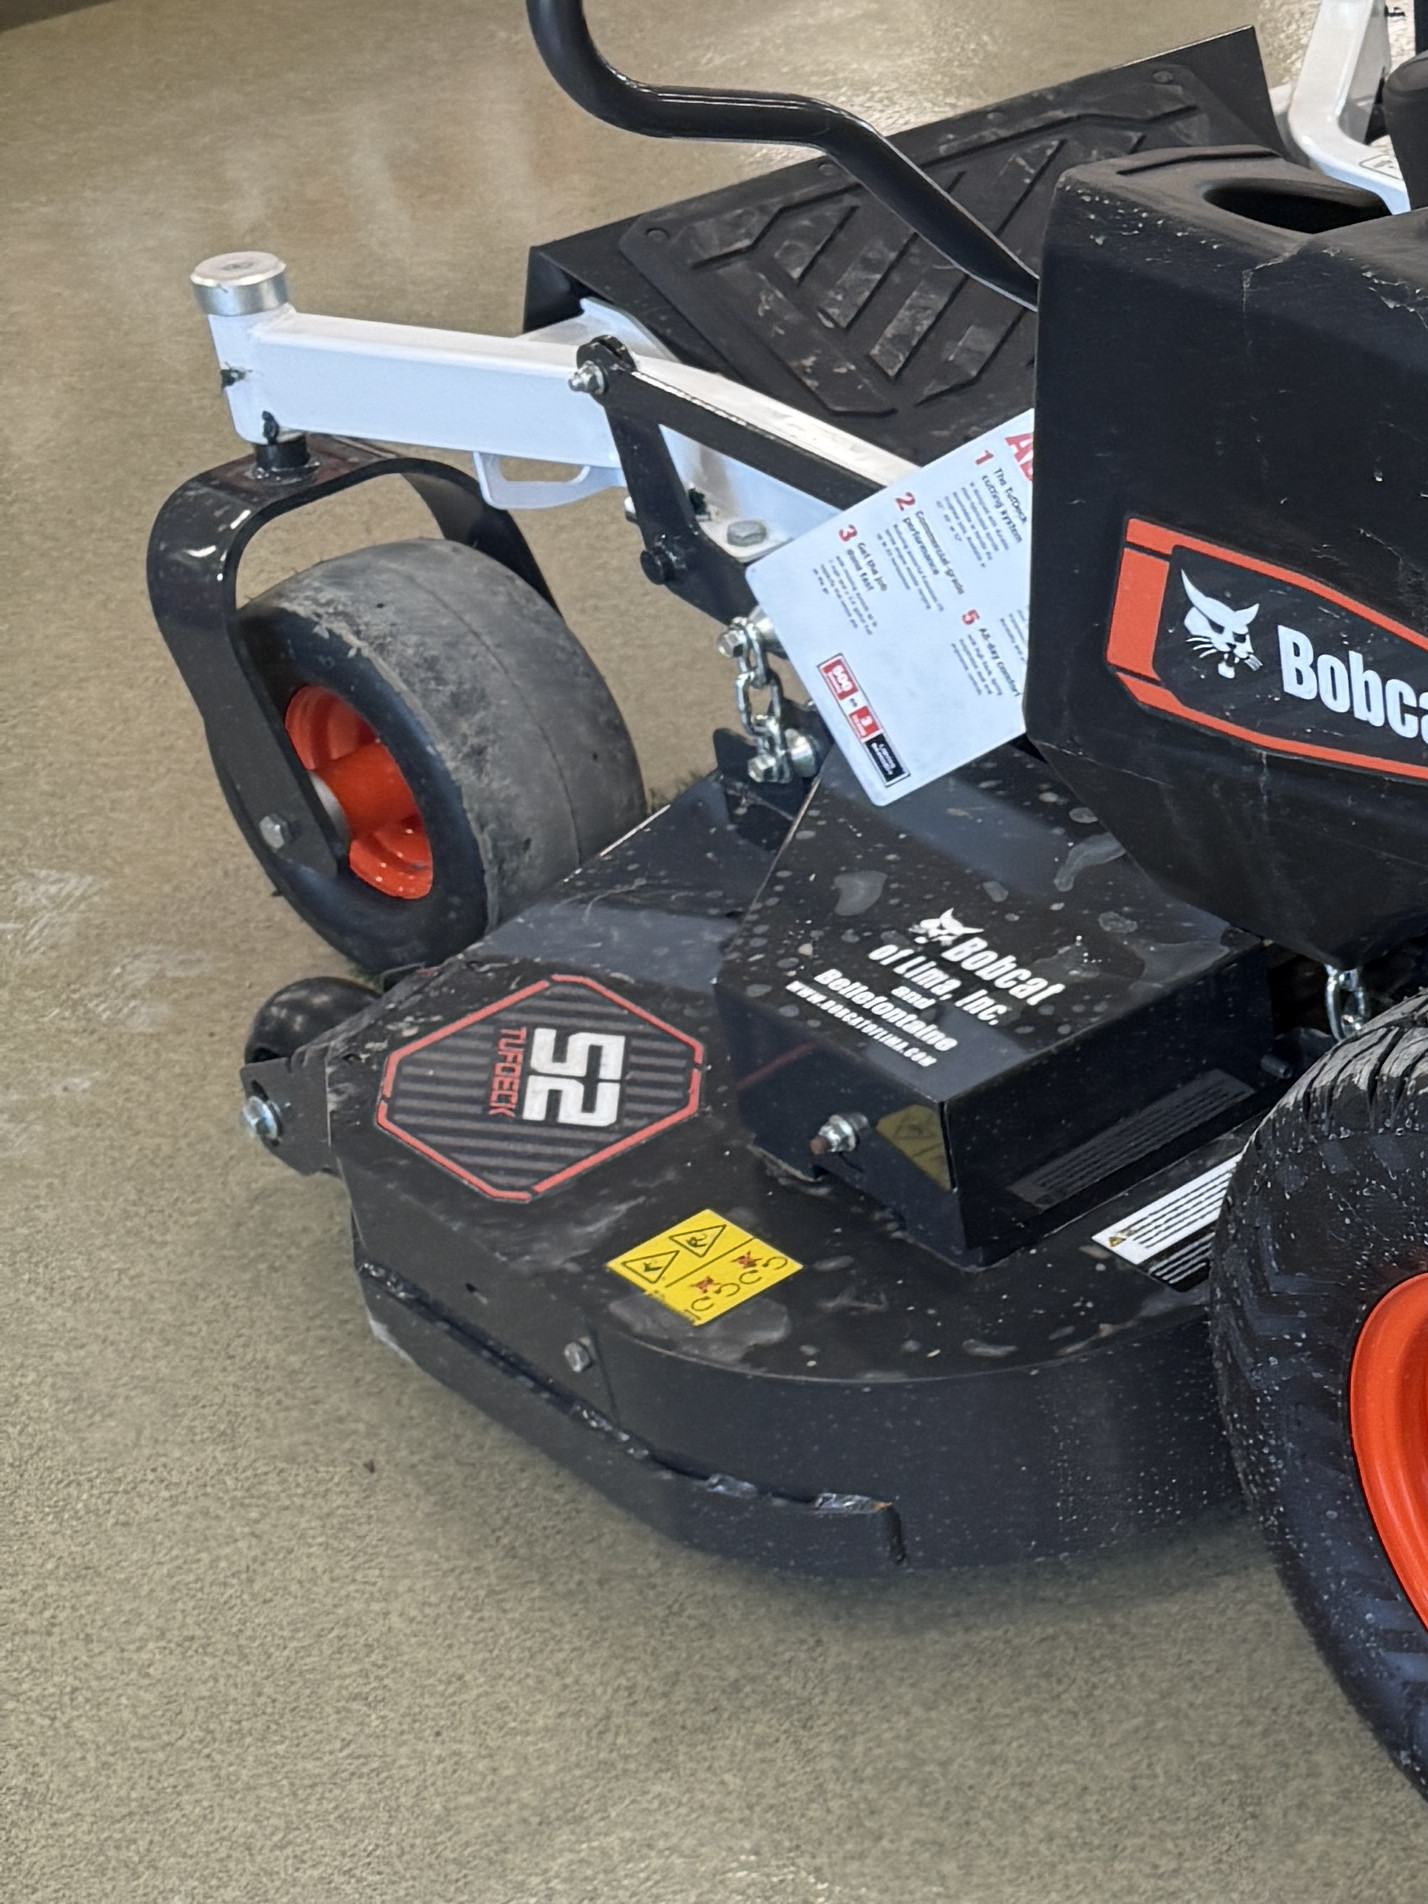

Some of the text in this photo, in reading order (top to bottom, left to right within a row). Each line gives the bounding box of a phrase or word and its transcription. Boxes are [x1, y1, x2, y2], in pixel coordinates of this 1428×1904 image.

[974, 449, 995, 467] 1
[895, 491, 916, 512] 2
[838, 523, 859, 543] 3
[961, 608, 981, 627] 5
[868, 944, 914, 966] of
[955, 988, 1008, 1026] Inc.
[941, 936, 1066, 1006] Bobcat
[813, 968, 959, 1052] Bellefontaine
[890, 985, 937, 1010] and
[487, 1026, 528, 1119] TUFDECK
[521, 1026, 627, 1128] 52
